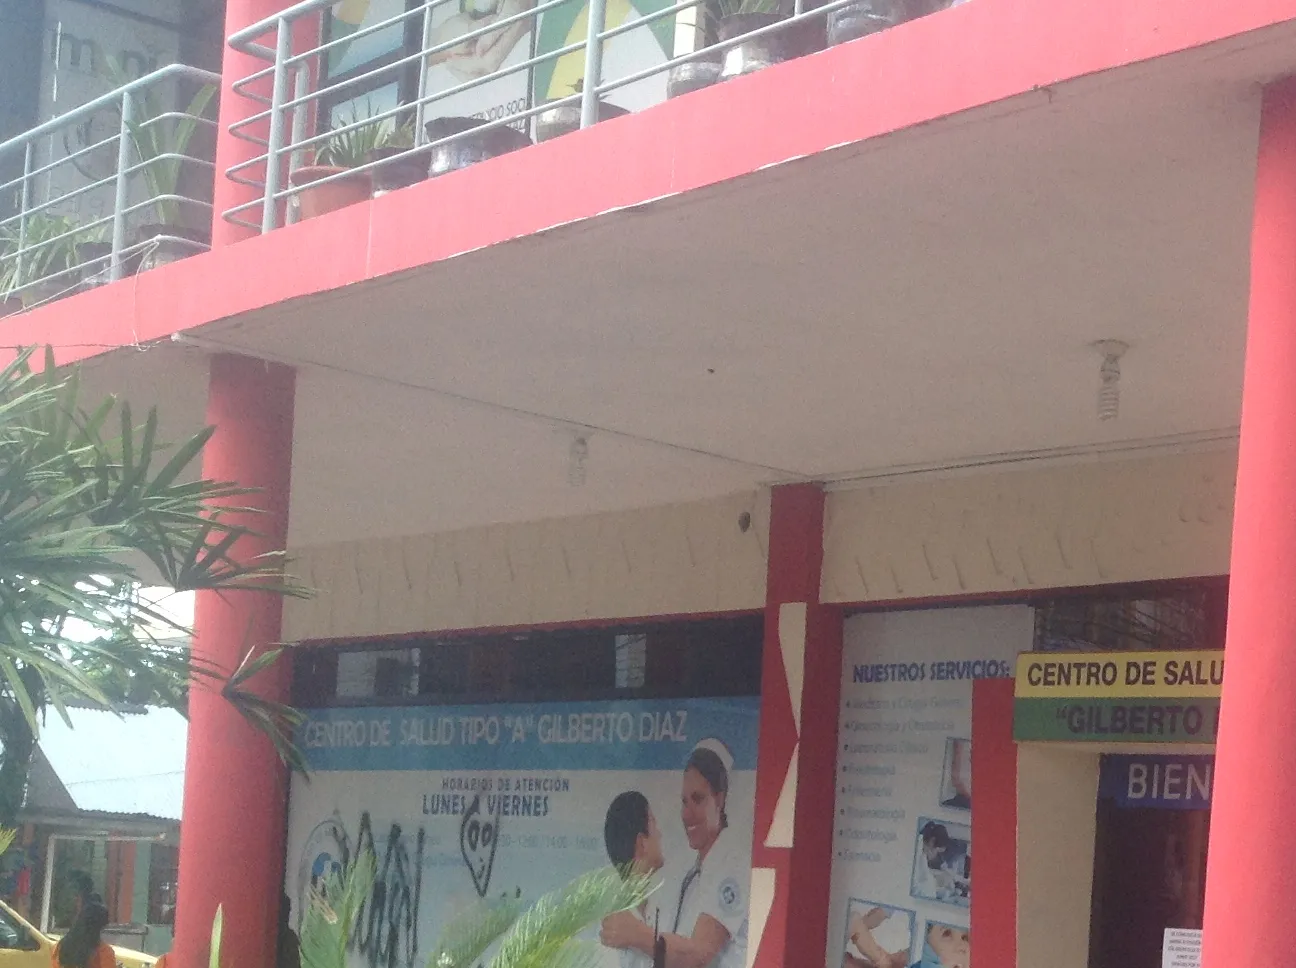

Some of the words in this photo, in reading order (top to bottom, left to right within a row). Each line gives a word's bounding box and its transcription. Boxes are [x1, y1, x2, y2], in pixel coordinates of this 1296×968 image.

[853, 662, 926, 683] NUESTROS
[930, 659, 1010, 682] SERVICIOS:
[1027, 662, 1118, 687] CENTRO
[1125, 661, 1157, 685] DE
[1163, 660, 1225, 686] SALU
[304, 719, 366, 748] CENTRO
[370, 718, 391, 747] DE
[401, 716, 455, 746] SALUD
[460, 716, 499, 745] TIPO
[537, 711, 633, 744] GILBERTO
[639, 710, 688, 743] DIAZ
[498, 777, 510, 792] DE
[1127, 763, 1213, 801] BIEN
[422, 794, 466, 816] LUNES
[487, 794, 549, 817] VIERNES
